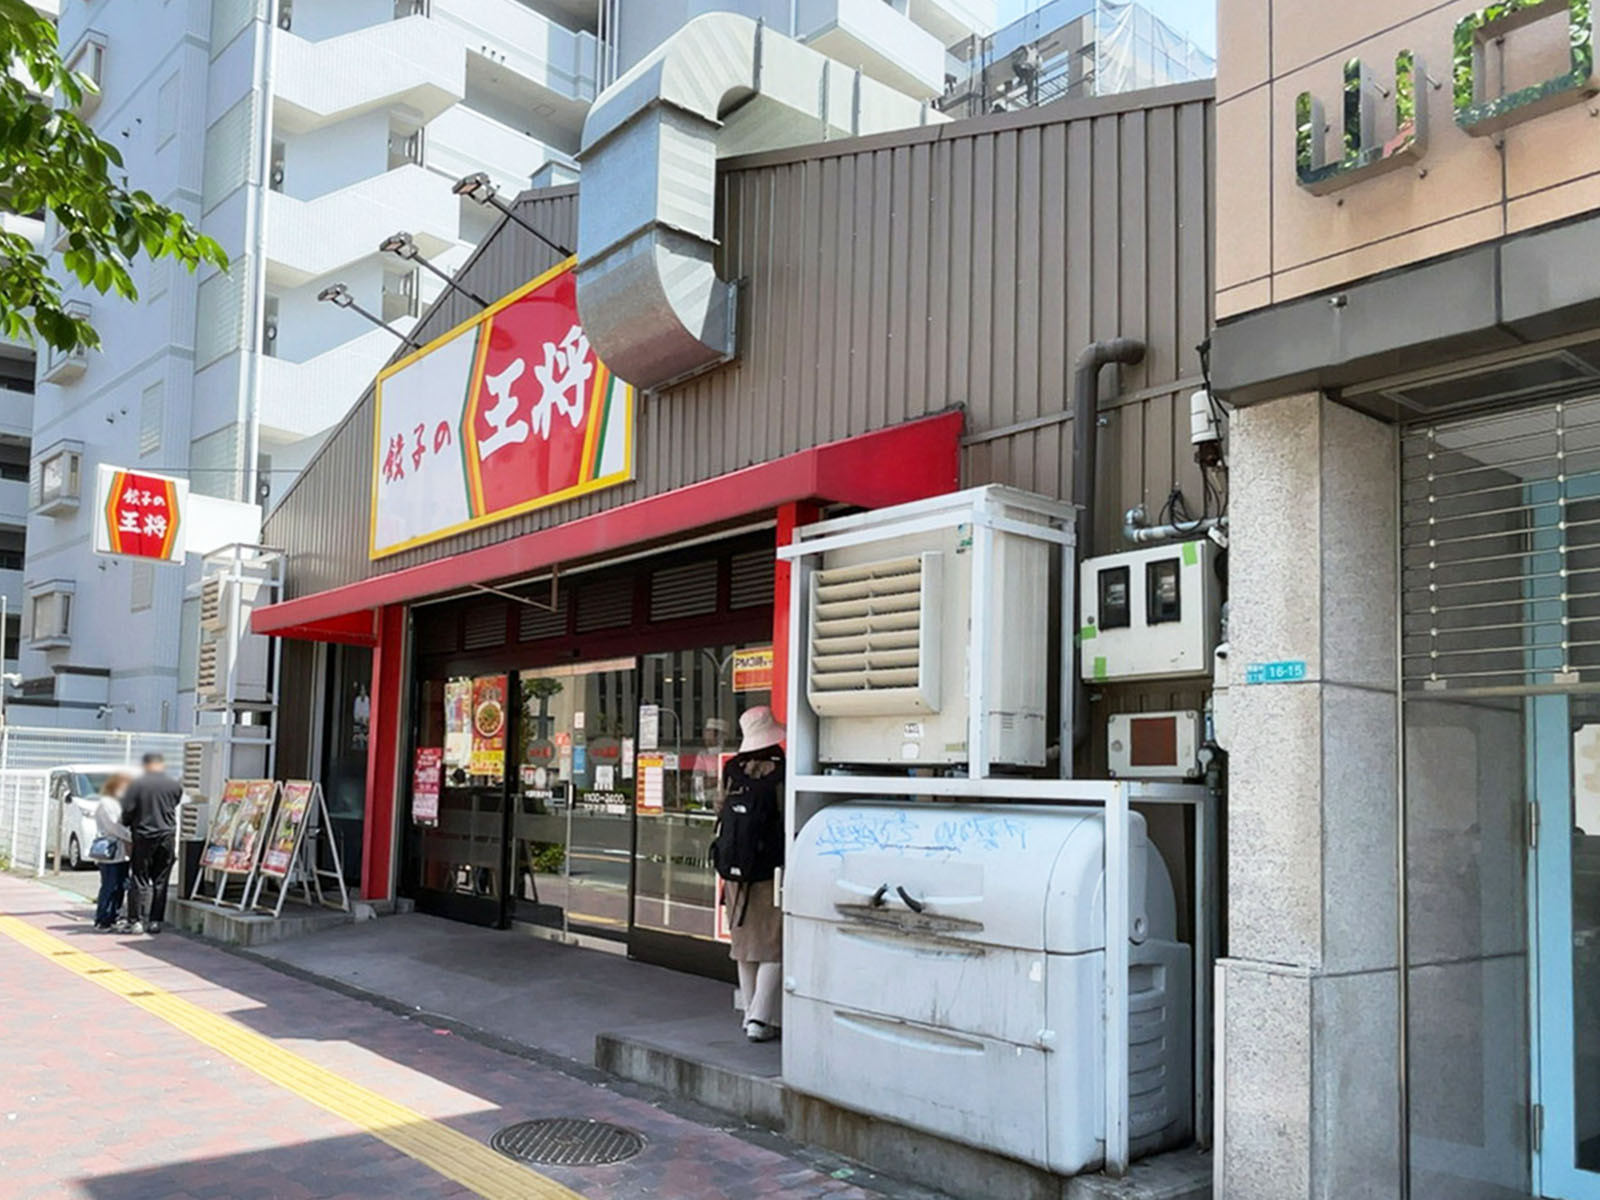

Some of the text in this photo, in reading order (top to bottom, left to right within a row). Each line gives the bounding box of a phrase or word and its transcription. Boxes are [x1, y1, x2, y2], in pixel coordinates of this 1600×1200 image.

[478, 324, 592, 462] 王将
[382, 420, 451, 485] 餃子の
[122, 487, 167, 508] 餃子の
[118, 509, 168, 540] 王将
[1269, 663, 1303, 678] 16-15
